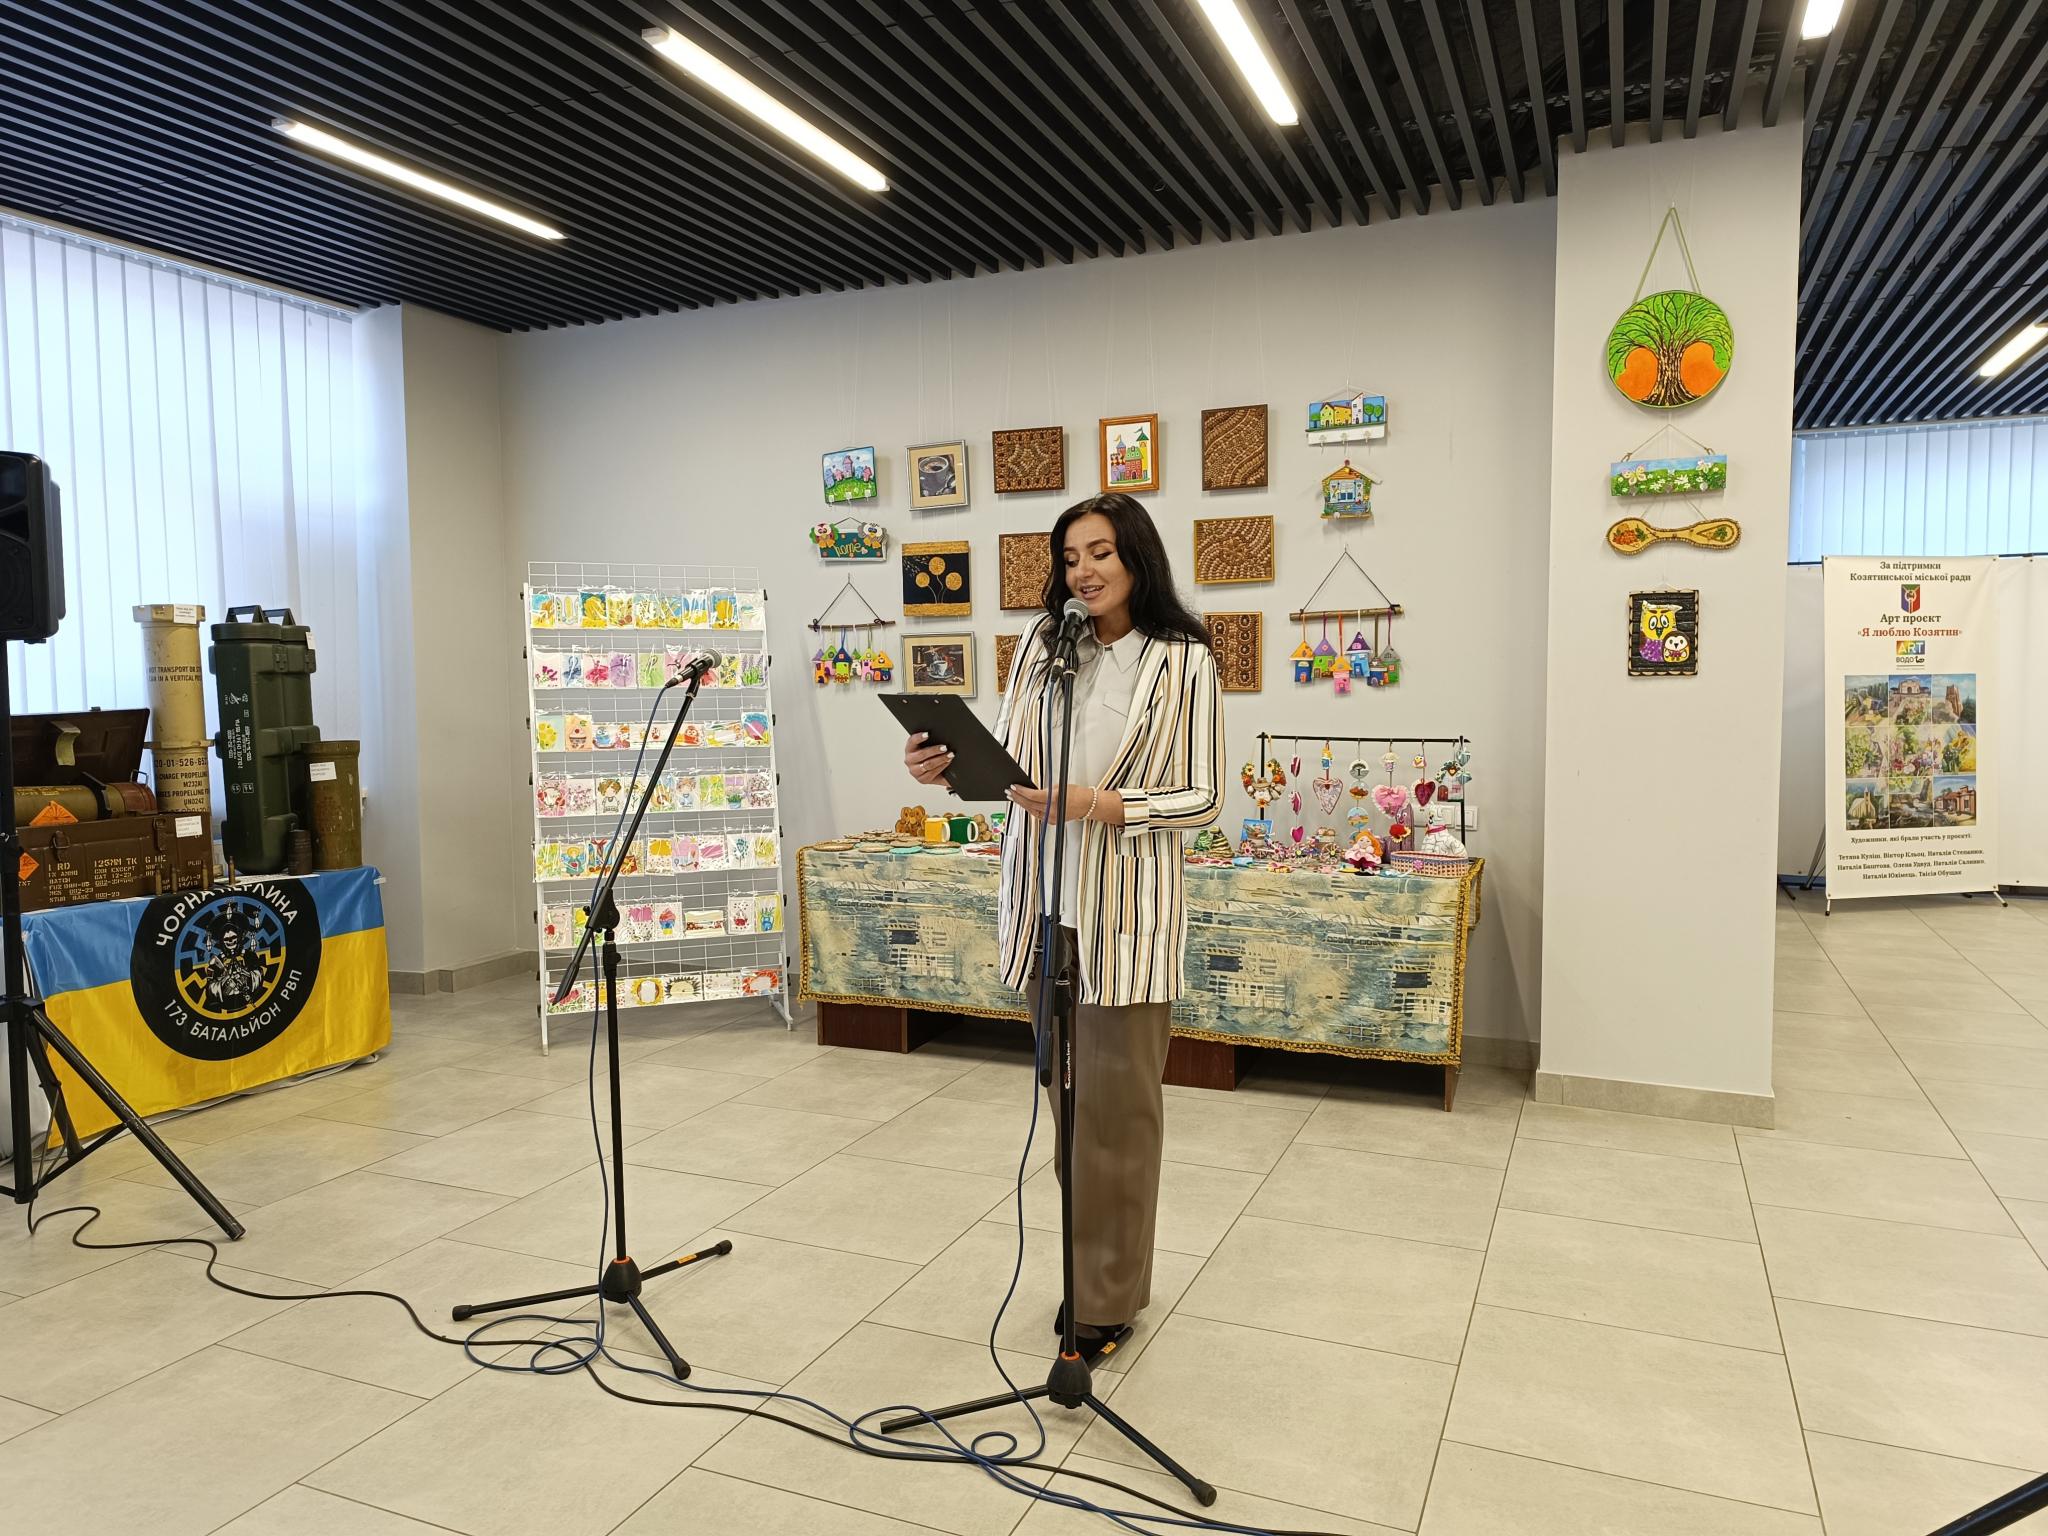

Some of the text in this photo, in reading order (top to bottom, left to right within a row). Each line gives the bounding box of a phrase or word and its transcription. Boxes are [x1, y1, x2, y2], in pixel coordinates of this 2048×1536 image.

[1880, 561, 1941, 571] За підтримки
[1850, 572, 1971, 583] Козятинської міської ради
[1880, 613, 1941, 625] Арт проєкт
[1873, 627, 1911, 637] люблю
[1897, 641, 1924, 654] ART
[158, 665, 189, 673] TRANSPORT
[170, 674, 194, 682] VERTICAL
[126, 857, 138, 865] TK
[57, 862, 71, 871] RD
[164, 969, 303, 1042] 173 БАТАЛЬЙОН РВП
